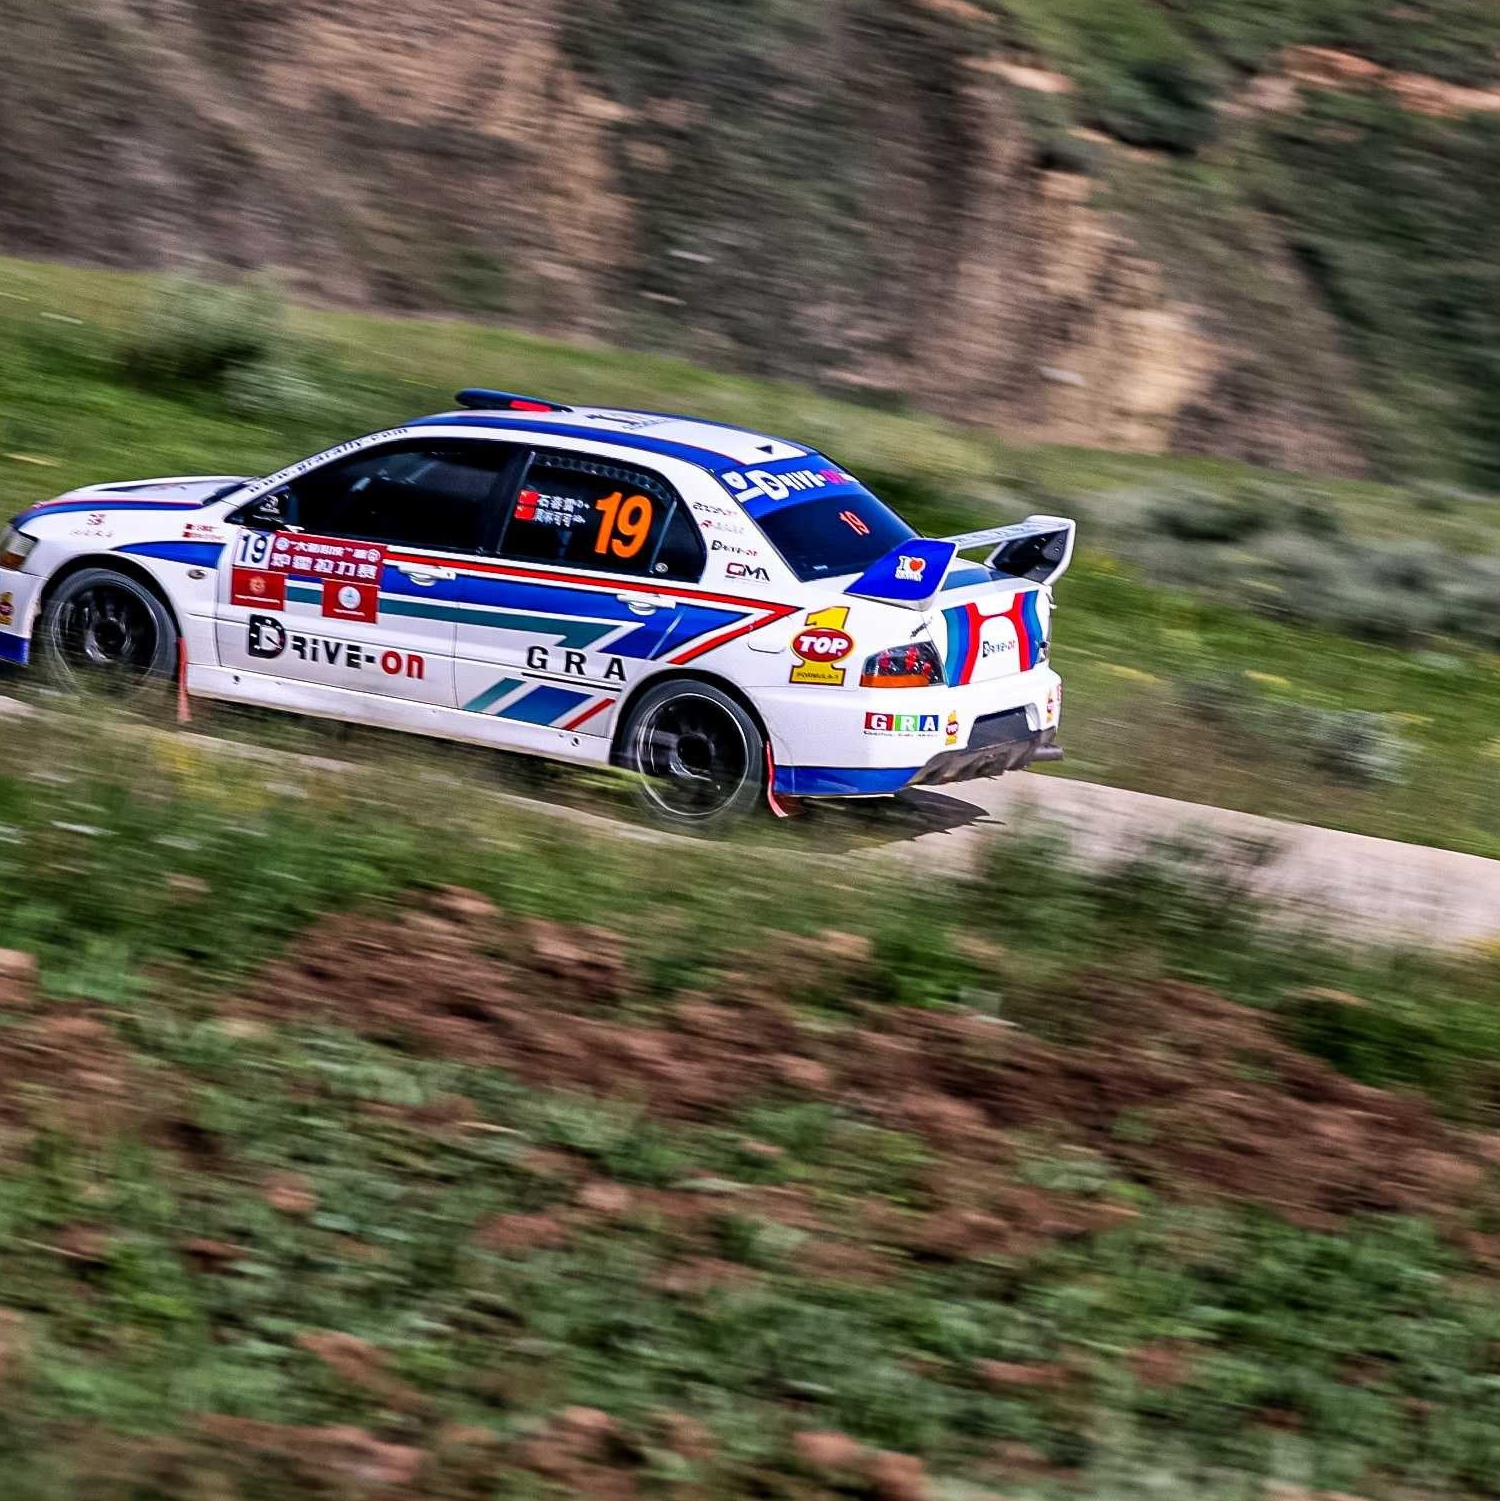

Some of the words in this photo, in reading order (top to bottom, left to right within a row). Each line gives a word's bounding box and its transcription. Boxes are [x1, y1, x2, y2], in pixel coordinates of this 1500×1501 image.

[594, 491, 653, 558] 19
[838, 510, 871, 536] 19
[240, 533, 268, 564] 19
[799, 635, 849, 655] TOP
[870, 714, 937, 732] GRA
